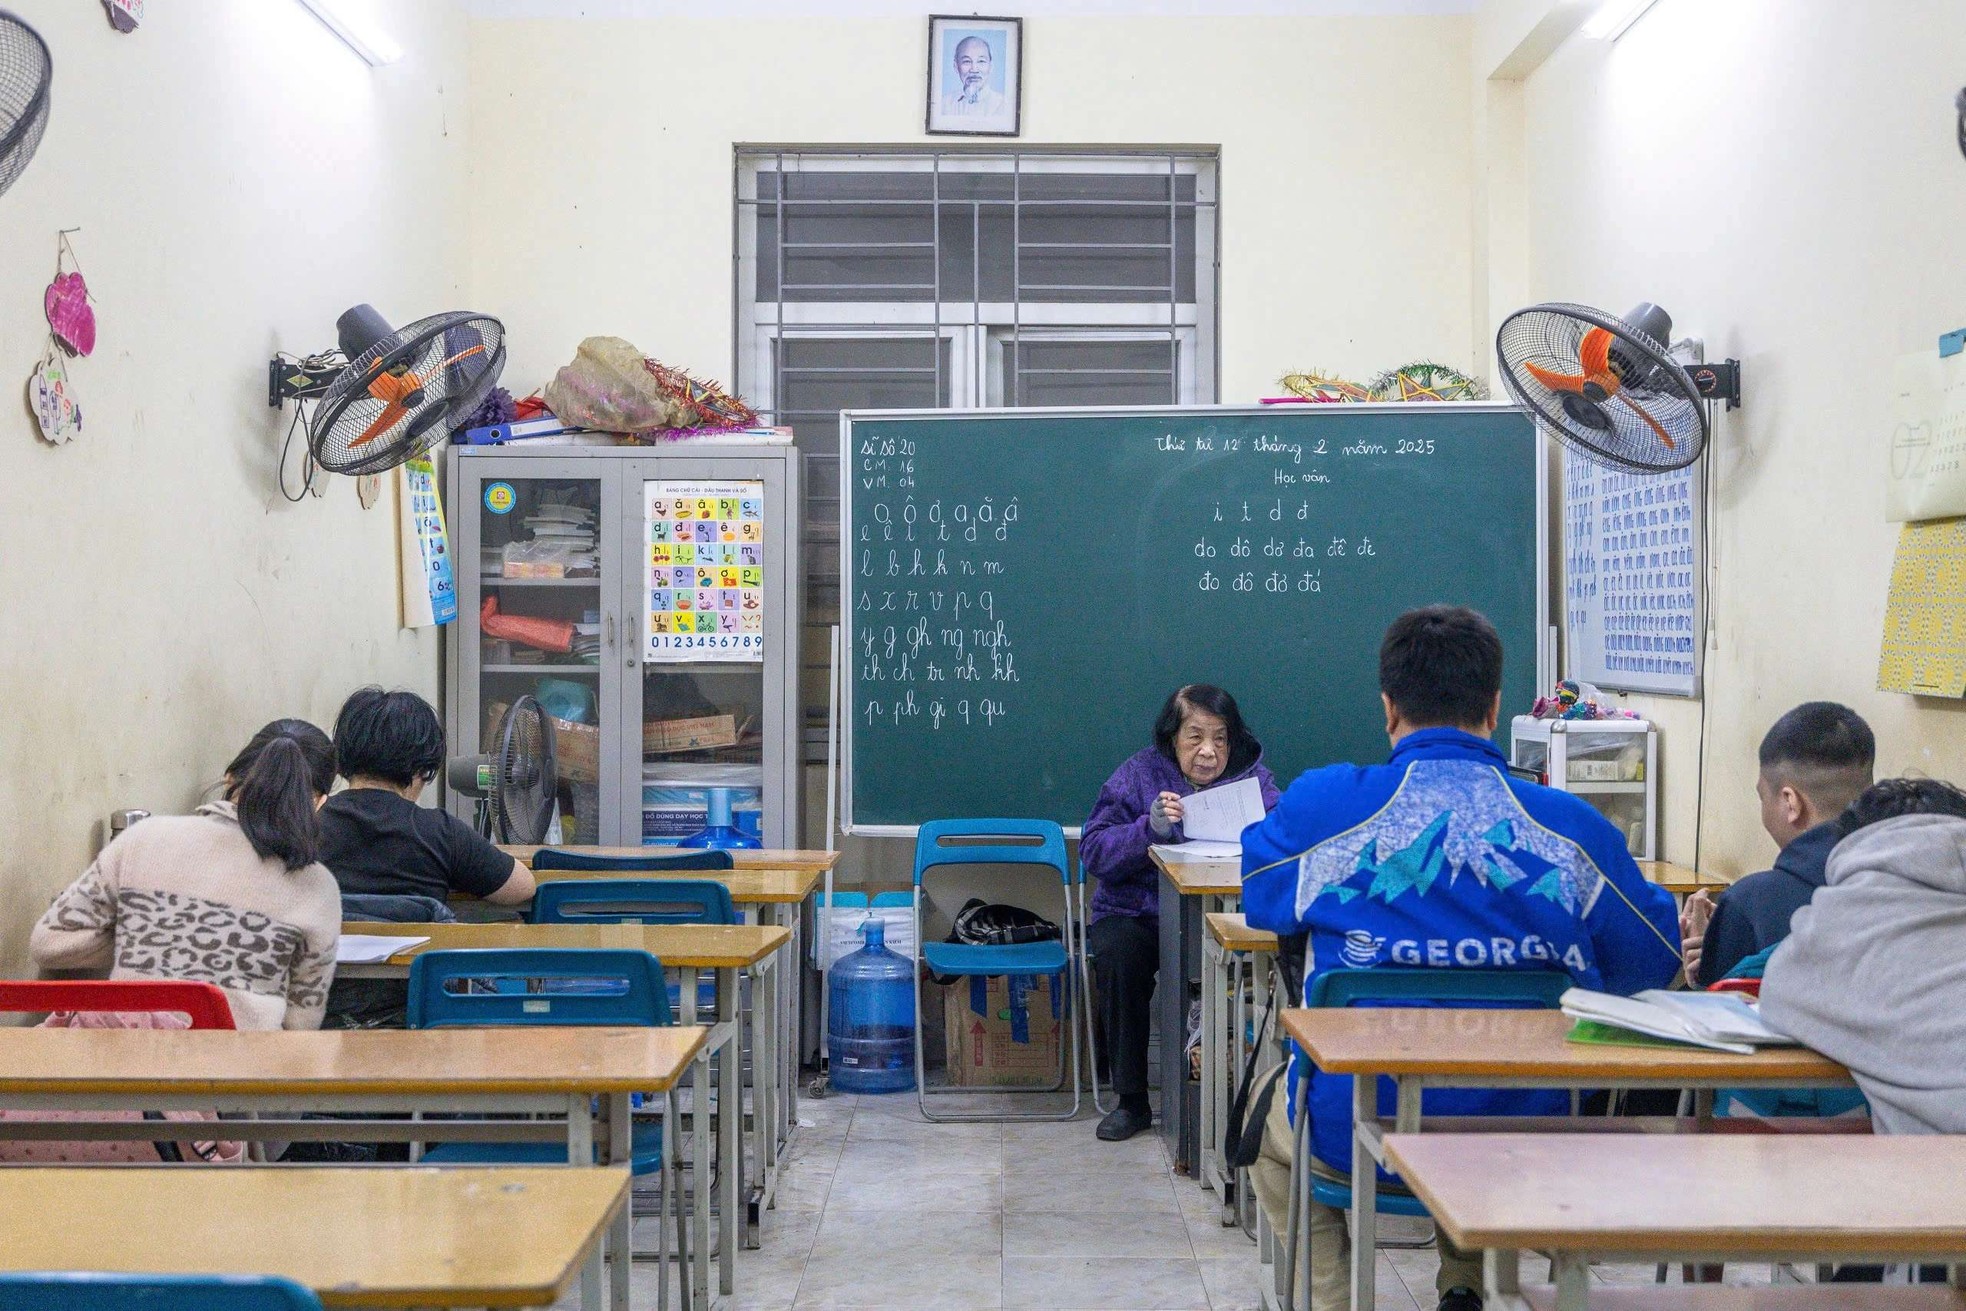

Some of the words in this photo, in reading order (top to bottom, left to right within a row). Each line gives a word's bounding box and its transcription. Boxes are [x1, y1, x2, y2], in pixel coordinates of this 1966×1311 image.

[900, 439, 915, 455] 20
[1224, 439, 1238, 450] 12
[1254, 435, 1302, 463] tháng
[1313, 439, 1327, 454] 2
[1342, 439, 1387, 456] năm
[1396, 439, 1435, 454] 2025
[900, 459, 914, 472] 16
[900, 476, 914, 487] 04
[1274, 468, 1296, 488] Học
[675, 499, 682, 508] ă
[721, 500, 728, 508] b
[955, 505, 966, 522] a
[979, 496, 992, 522] ă
[1005, 496, 1018, 521] â
[1214, 502, 1222, 521] i
[1241, 501, 1251, 521] t
[1270, 498, 1280, 521] d
[1297, 500, 1308, 519] đ
[654, 522, 661, 532] d
[675, 522, 682, 532] đ
[698, 524, 705, 532] e
[721, 522, 728, 532] ê
[743, 524, 750, 534] g
[861, 525, 870, 541] e
[884, 520, 893, 541] ê
[937, 520, 950, 541] t
[965, 517, 976, 541] d
[995, 519, 1007, 541] đ
[655, 545, 660, 554] h
[698, 545, 704, 554] k
[1195, 537, 1216, 557] do
[1231, 536, 1250, 557] dô
[1293, 537, 1314, 557] đa
[1328, 536, 1347, 556] đê
[1357, 536, 1376, 556] đe
[861, 550, 873, 576] l
[886, 550, 899, 576] b
[908, 549, 926, 576] h
[933, 549, 948, 575] k
[960, 561, 976, 575] n
[983, 561, 1004, 575] m
[698, 568, 705, 577] ô
[721, 569, 728, 577] ơ
[744, 570, 750, 579] p
[1199, 570, 1219, 590] đo
[1233, 572, 1253, 591] đô
[1298, 569, 1320, 592] đá
[654, 592, 660, 602] q
[744, 592, 750, 600] u
[857, 591, 871, 611] s
[880, 591, 896, 611] x
[906, 590, 919, 610] r
[930, 591, 943, 611] v
[953, 592, 971, 621] p
[980, 591, 993, 620] q
[721, 615, 728, 624] y
[652, 636, 659, 647] 0
[665, 636, 668, 647] 1
[674, 636, 681, 647] 2
[686, 636, 693, 647] 3
[697, 636, 704, 647] 4
[709, 636, 716, 647] 5
[721, 636, 728, 647] 6
[733, 636, 739, 647] 7
[744, 636, 750, 647] 8
[755, 636, 762, 647] 9
[861, 627, 875, 657] y
[884, 626, 896, 659] g
[906, 616, 931, 659] gh
[941, 629, 963, 660] ng
[973, 620, 1011, 660] ngh
[861, 654, 885, 681] th
[893, 653, 915, 681] ch
[927, 661, 944, 680] tr
[954, 654, 980, 681] nh
[991, 653, 1020, 681] kh
[865, 700, 883, 725] p
[893, 690, 920, 725] ph
[930, 697, 945, 729] gi
[958, 700, 969, 724] q
[980, 699, 1006, 726] qu
